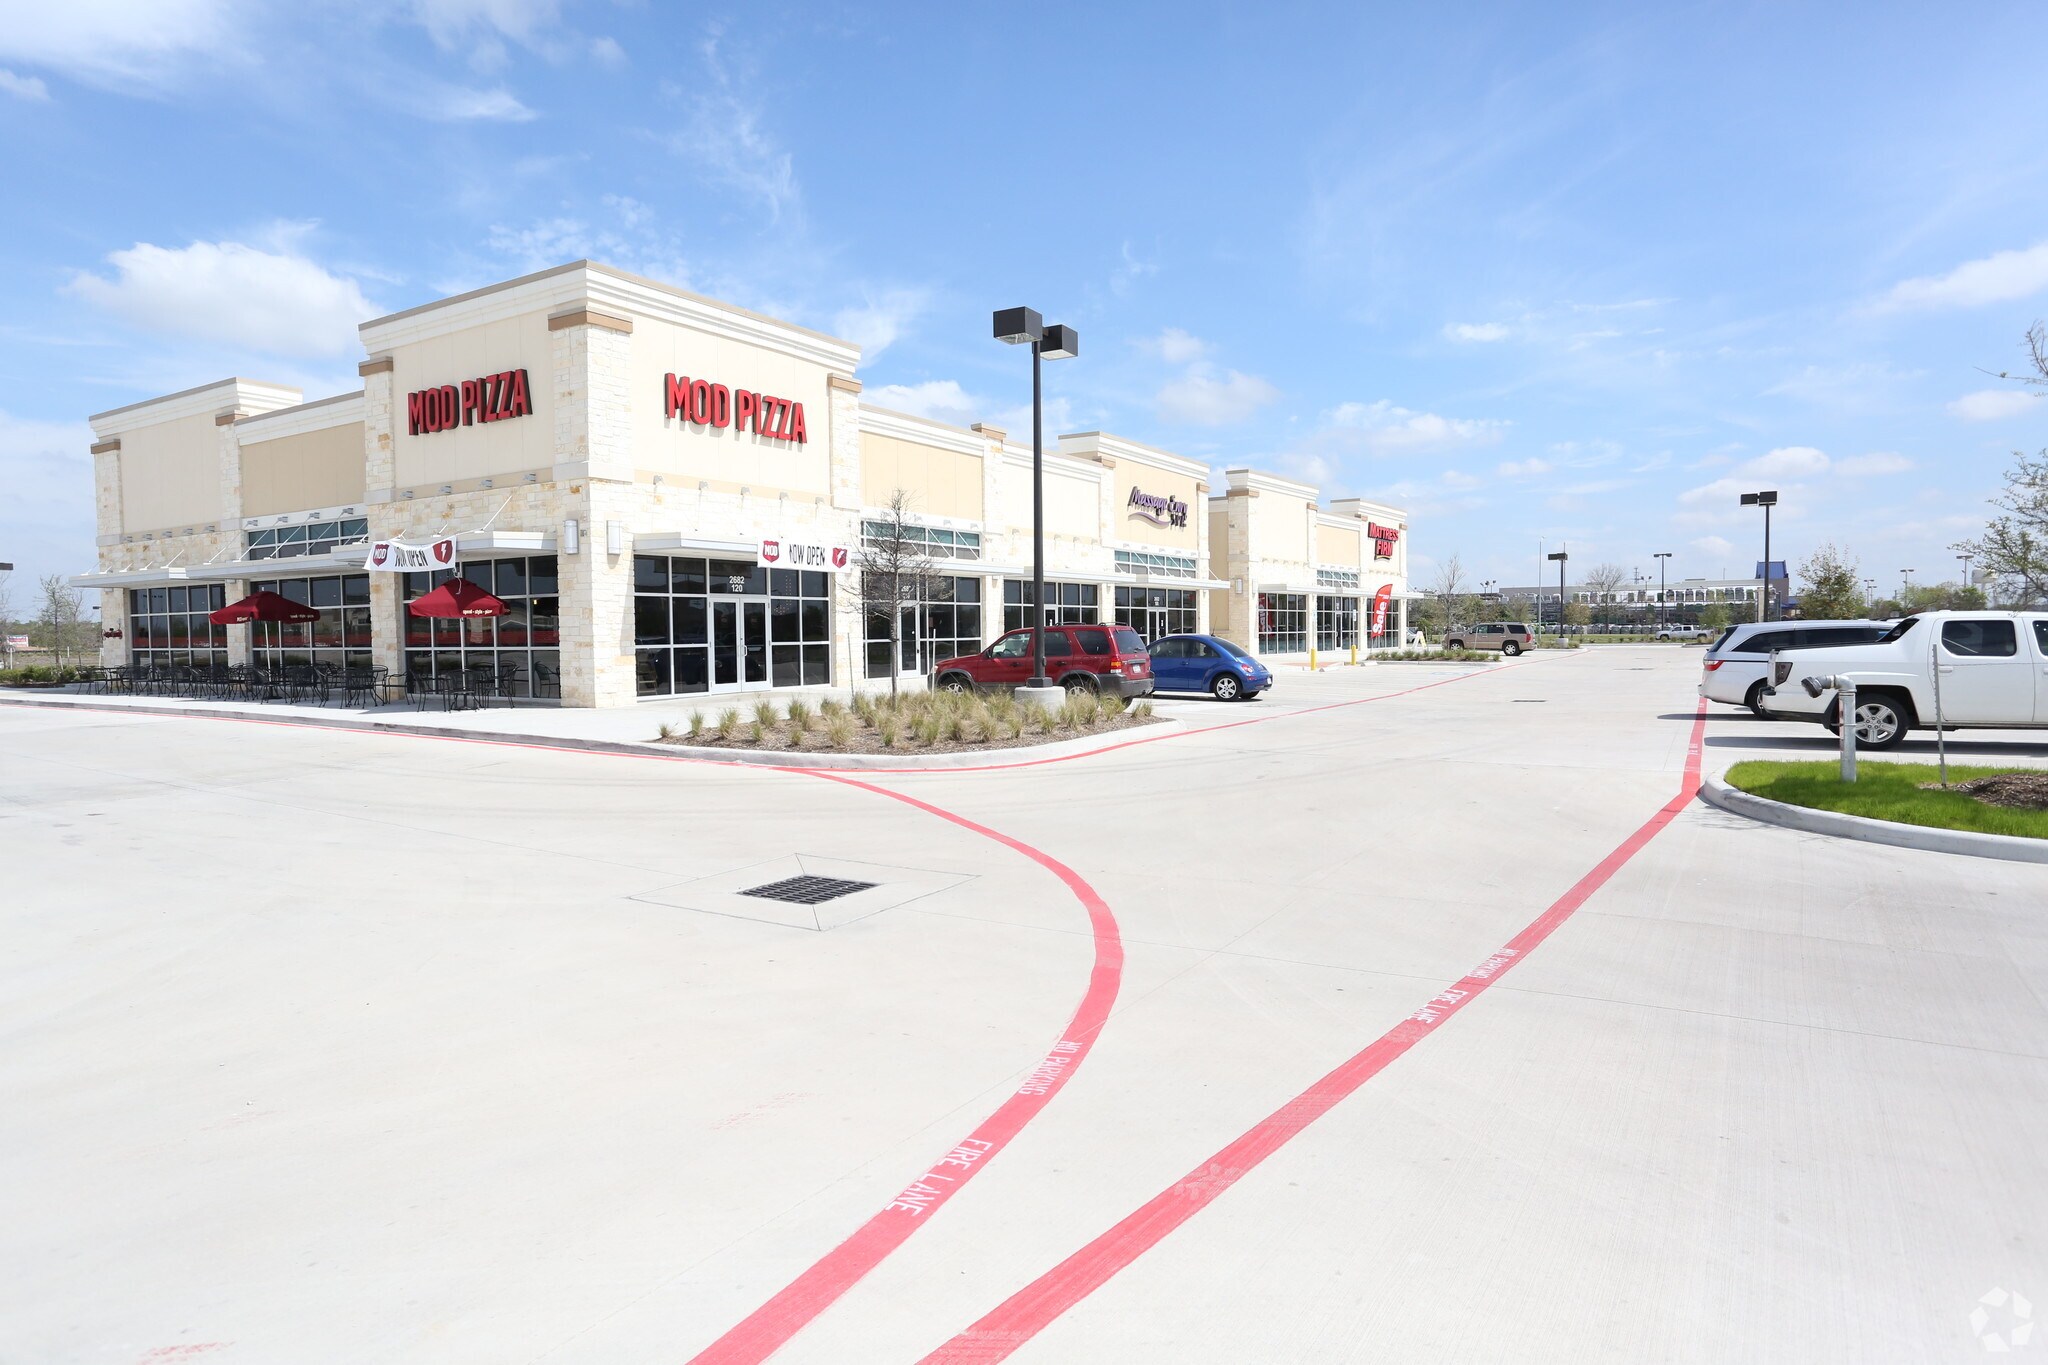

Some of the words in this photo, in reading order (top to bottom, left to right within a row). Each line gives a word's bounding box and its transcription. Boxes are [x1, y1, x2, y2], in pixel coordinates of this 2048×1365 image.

[408, 384, 460, 436] MOD
[461, 368, 533, 427] PIZZA
[664, 372, 731, 429] MOD
[734, 388, 808, 444] PIZZA
[1127, 486, 1168, 517] Massage
[1368, 521, 1399, 542] MATTRESS
[764, 544, 779, 557] MOD
[789, 543, 805, 564] NOW
[806, 545, 826, 566] OPEN
[1375, 539, 1393, 557] FIRM
[729, 575, 745, 584] 2682
[731, 584, 743, 593] 120
[1372, 601, 1387, 634] Sale
[1431, 989, 1468, 1004] FIRE
[1406, 1004, 1448, 1023] LANE
[1053, 1040, 1083, 1054] NO
[1018, 1056, 1071, 1096] PARKING
[937, 1138, 993, 1171] FIRE
[885, 1172, 954, 1217] LANE
